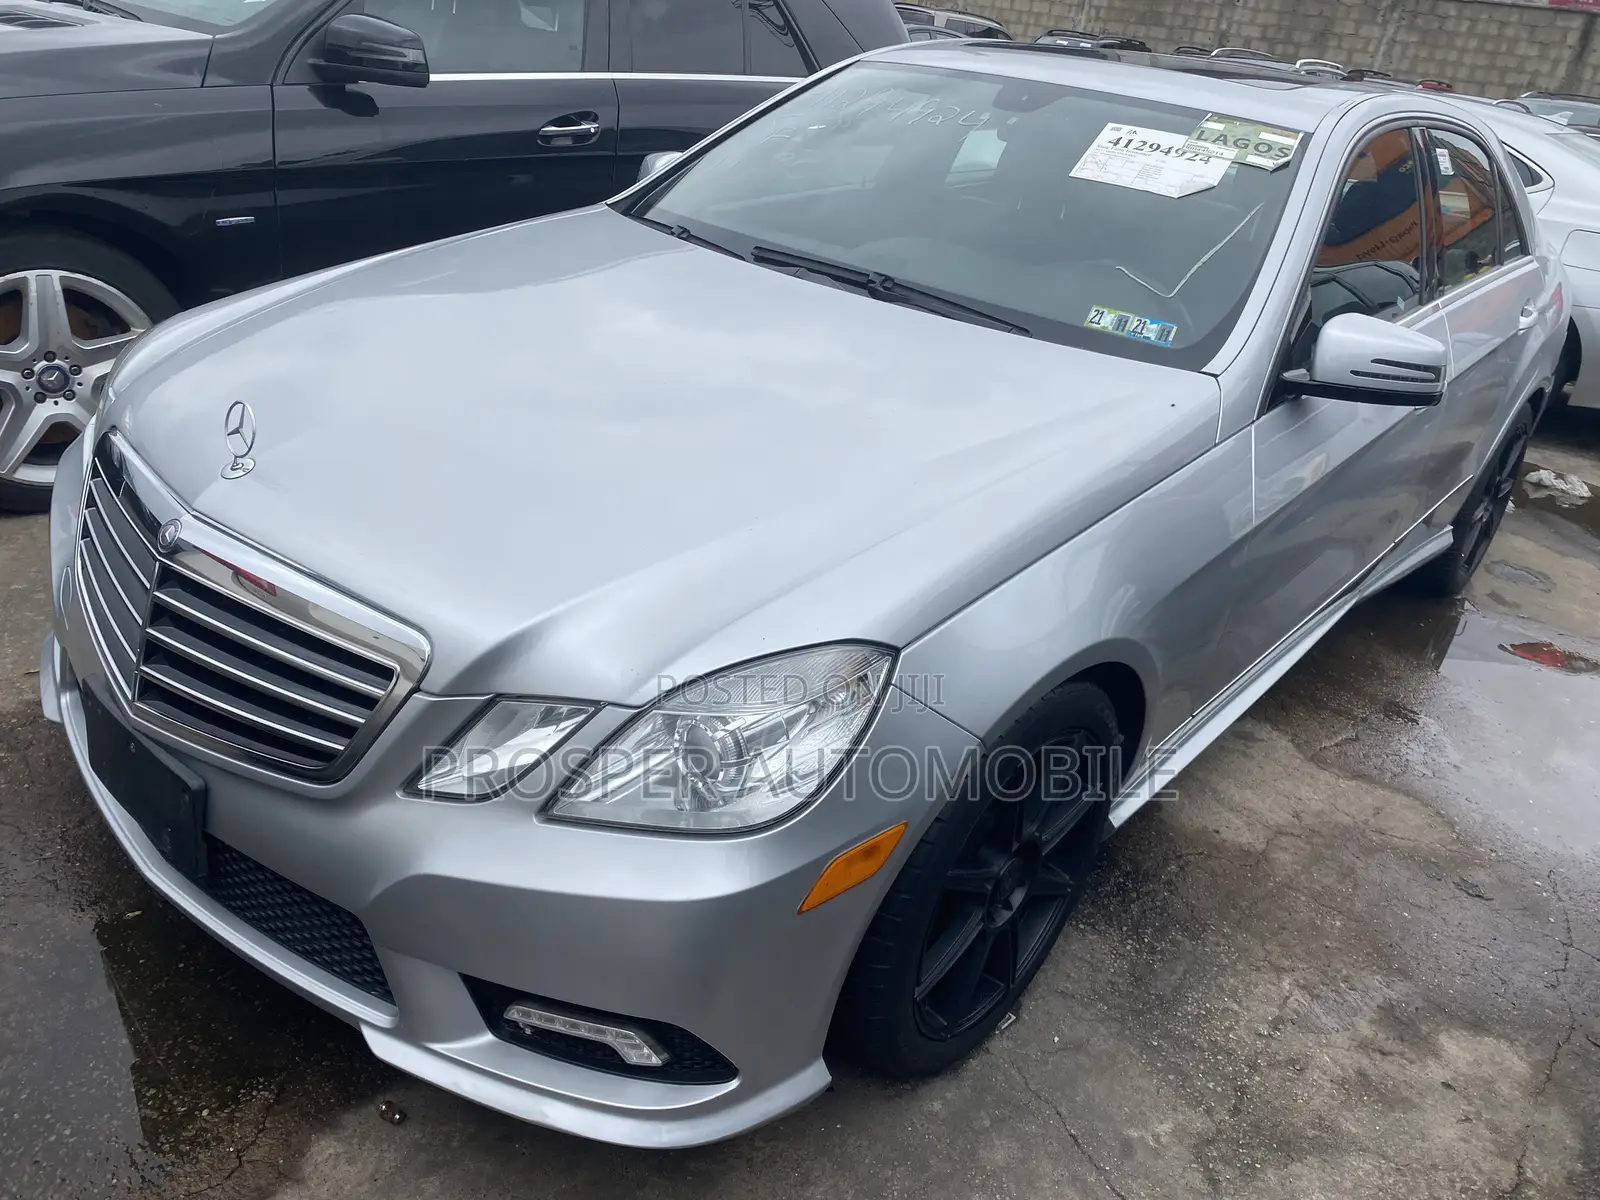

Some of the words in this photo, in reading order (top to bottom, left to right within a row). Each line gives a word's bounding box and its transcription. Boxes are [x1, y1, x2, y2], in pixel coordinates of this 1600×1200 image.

[1107, 136, 1212, 165] 41294924
[1195, 129, 1291, 158] LAGOS
[1089, 309, 1104, 325] 21
[1115, 318, 1129, 333] 11
[1131, 318, 1147, 336] 21
[1158, 327, 1171, 343] 11
